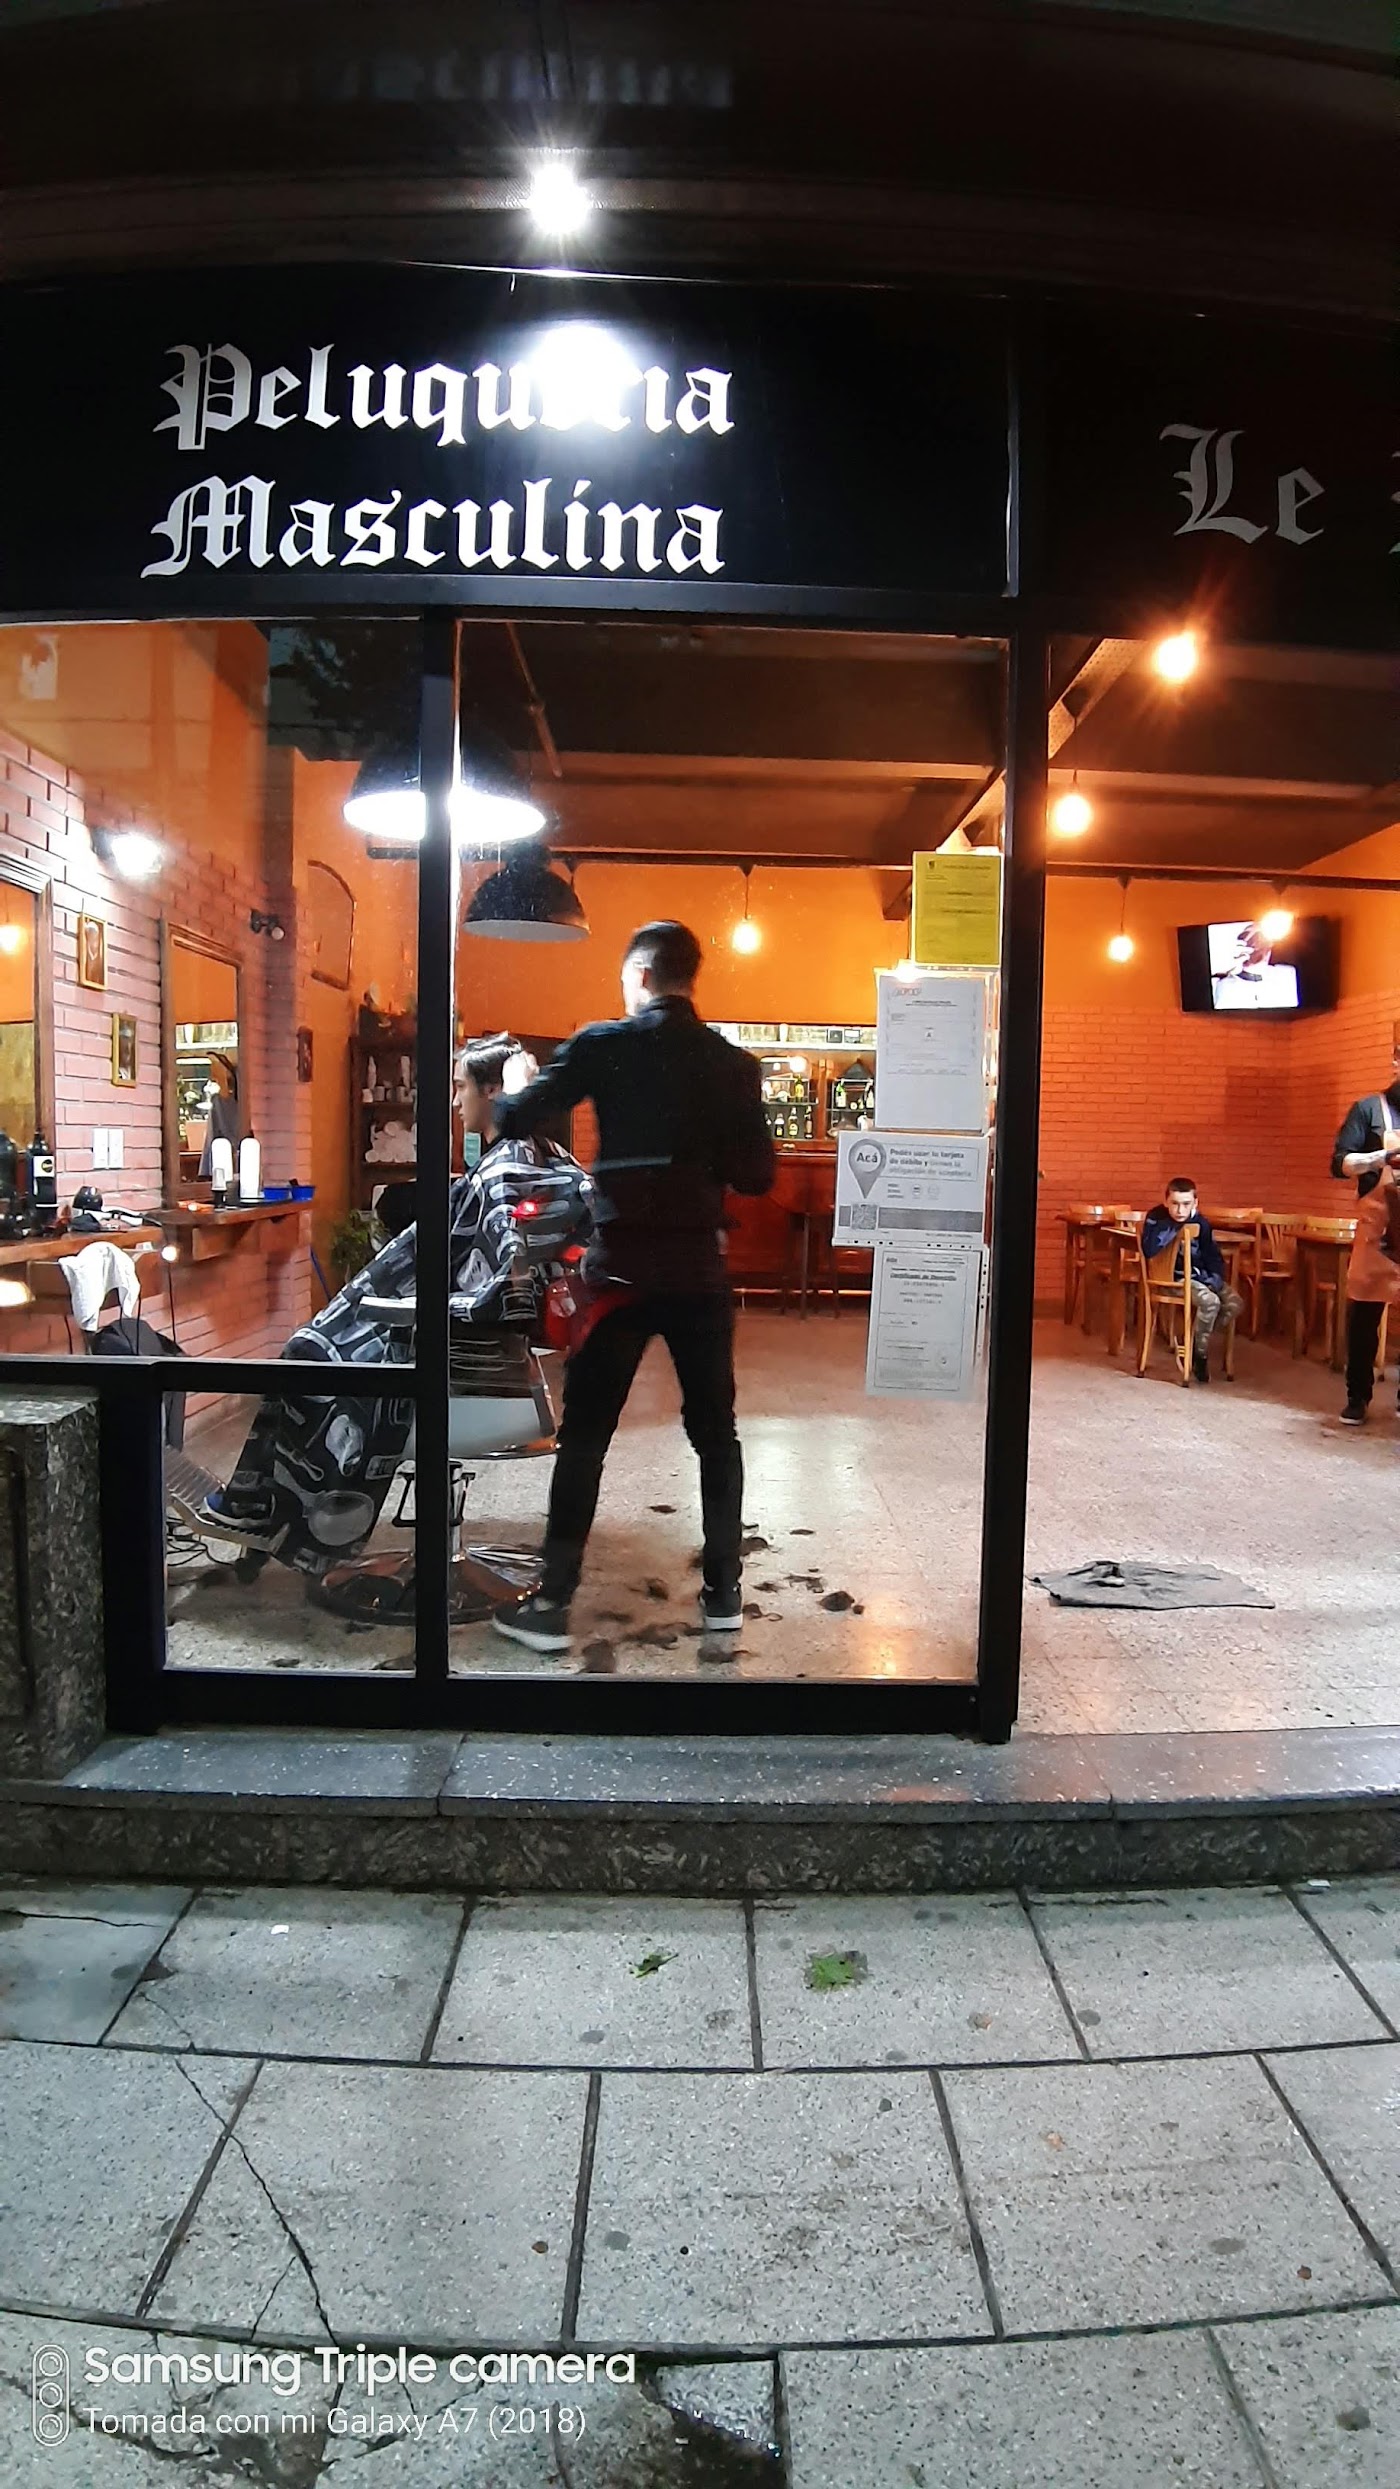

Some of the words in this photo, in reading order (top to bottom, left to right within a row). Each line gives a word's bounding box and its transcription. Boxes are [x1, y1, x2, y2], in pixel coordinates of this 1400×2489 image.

[141, 475, 725, 578] Masculina
[1159, 423, 1325, 545] Le
[856, 1152, 878, 1163] Acá
